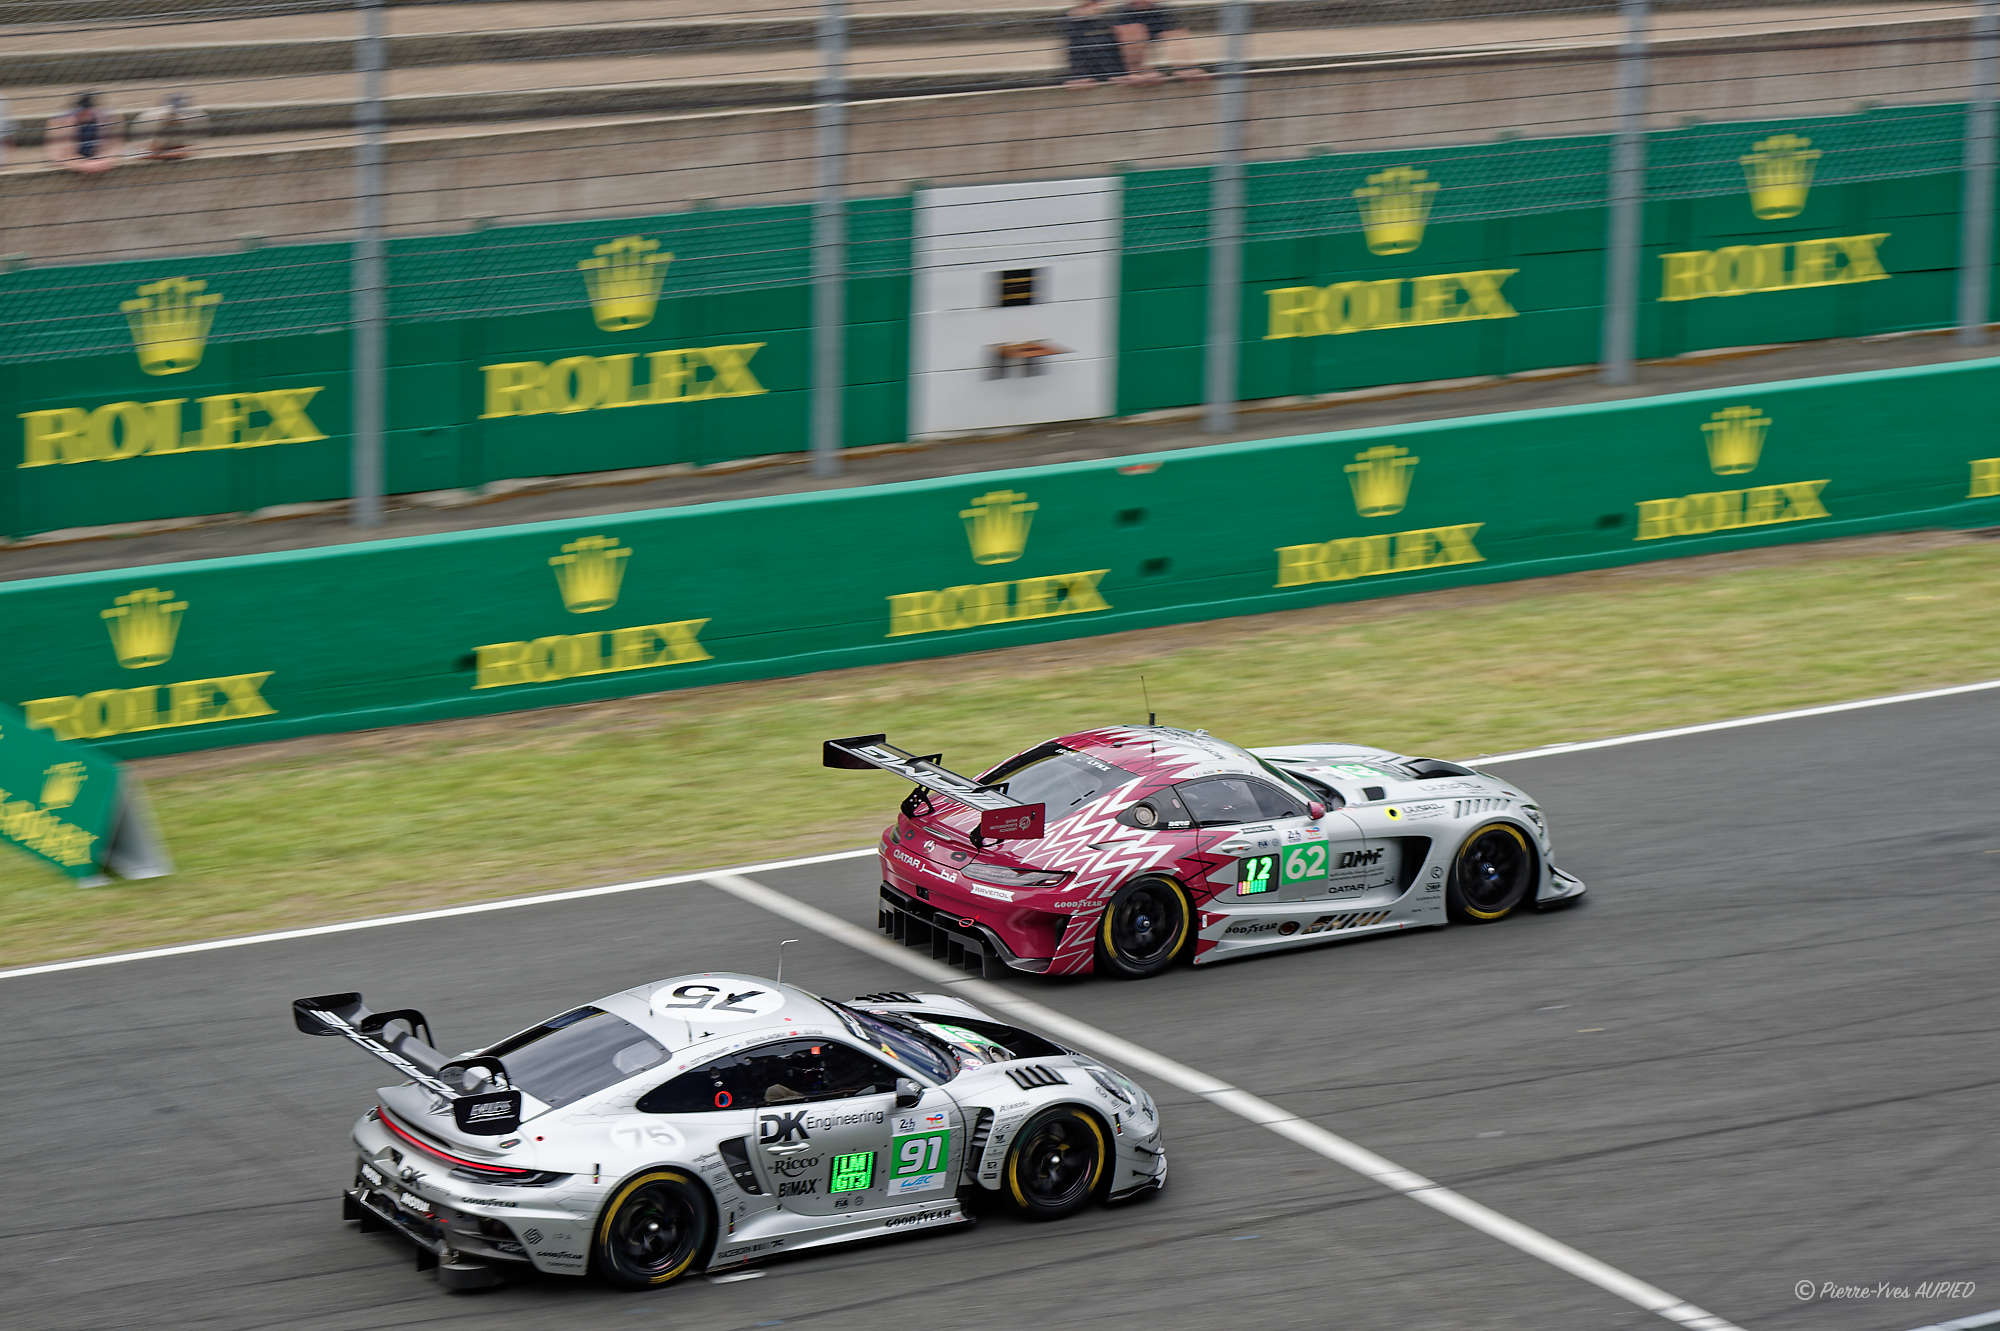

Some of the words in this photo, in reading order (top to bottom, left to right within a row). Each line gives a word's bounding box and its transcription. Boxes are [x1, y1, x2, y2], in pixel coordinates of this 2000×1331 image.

[1658, 233, 1891, 302] ROLEX
[1263, 269, 1519, 339] ROLEX
[478, 342, 768, 419] ROLEX
[17, 386, 328, 468] ROLEX
[1634, 480, 1831, 541] ROLEX
[1274, 523, 1487, 588] ROLEX
[886, 569, 1113, 637] ROLEX
[471, 618, 714, 690] ROLEX
[19, 671, 278, 741] ROLEX
[893, 849, 921, 868] QATAR
[1246, 856, 1273, 881] 12
[1286, 845, 1327, 880] 62
[1054, 899, 1103, 910] GOODYEAR
[617, 1125, 678, 1149] 75
[760, 1109, 811, 1145] DK
[807, 1110, 885, 1131] Engineering
[840, 1154, 868, 1173] LM
[898, 1136, 942, 1175] 91
[836, 1171, 867, 1190] GT3
[885, 1209, 952, 1228] GOODYEAR
